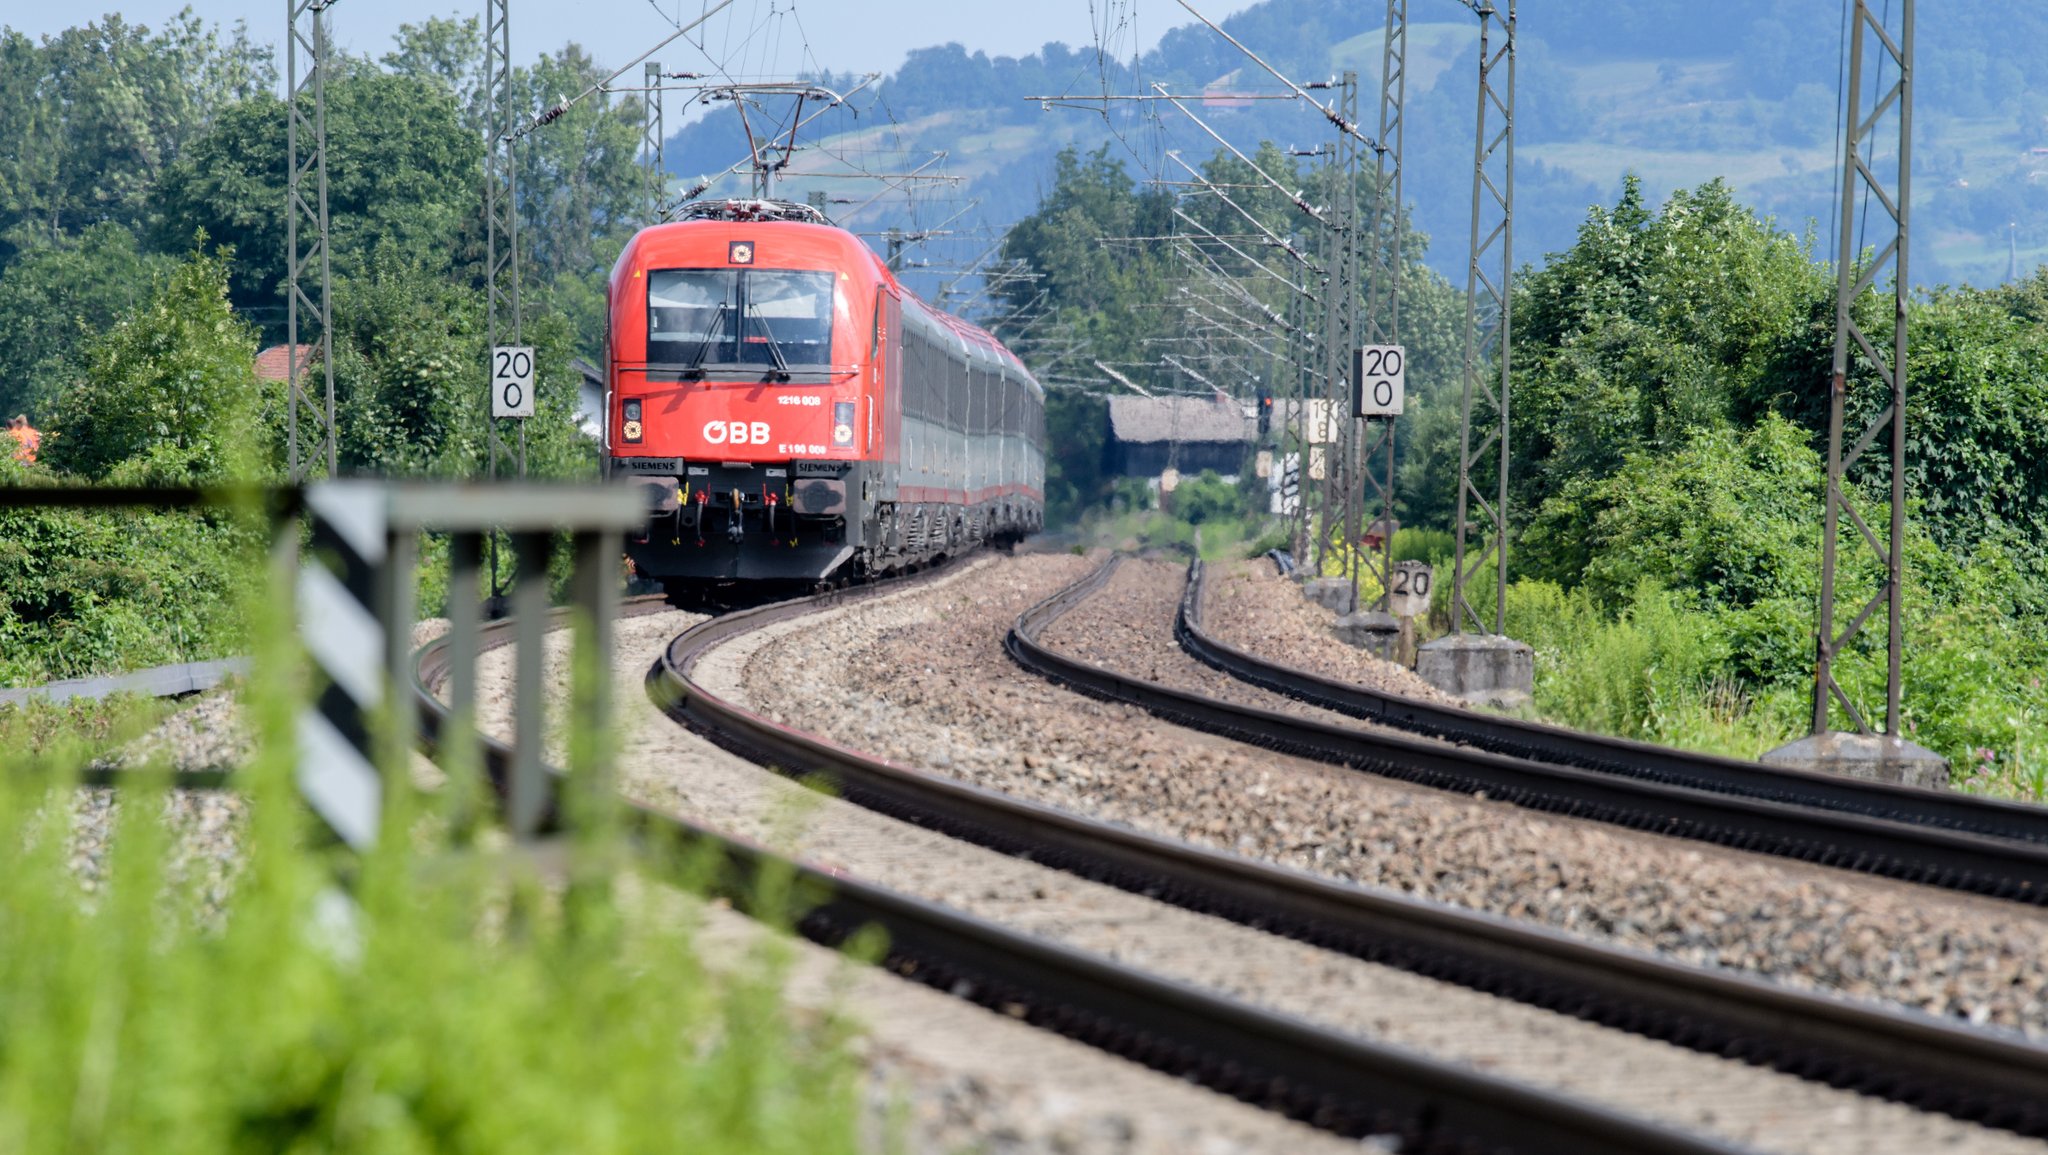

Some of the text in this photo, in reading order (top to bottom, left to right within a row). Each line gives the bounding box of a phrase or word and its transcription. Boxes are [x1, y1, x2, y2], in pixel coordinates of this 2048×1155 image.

[496, 351, 530, 379] 20
[1366, 349, 1401, 376] 20
[504, 382, 522, 409] 0
[1374, 380, 1392, 407] 0
[778, 443, 787, 454] E
[632, 462, 676, 471] SIEMENS
[799, 463, 842, 472] SIEMENS
[1393, 569, 1429, 596] 20
